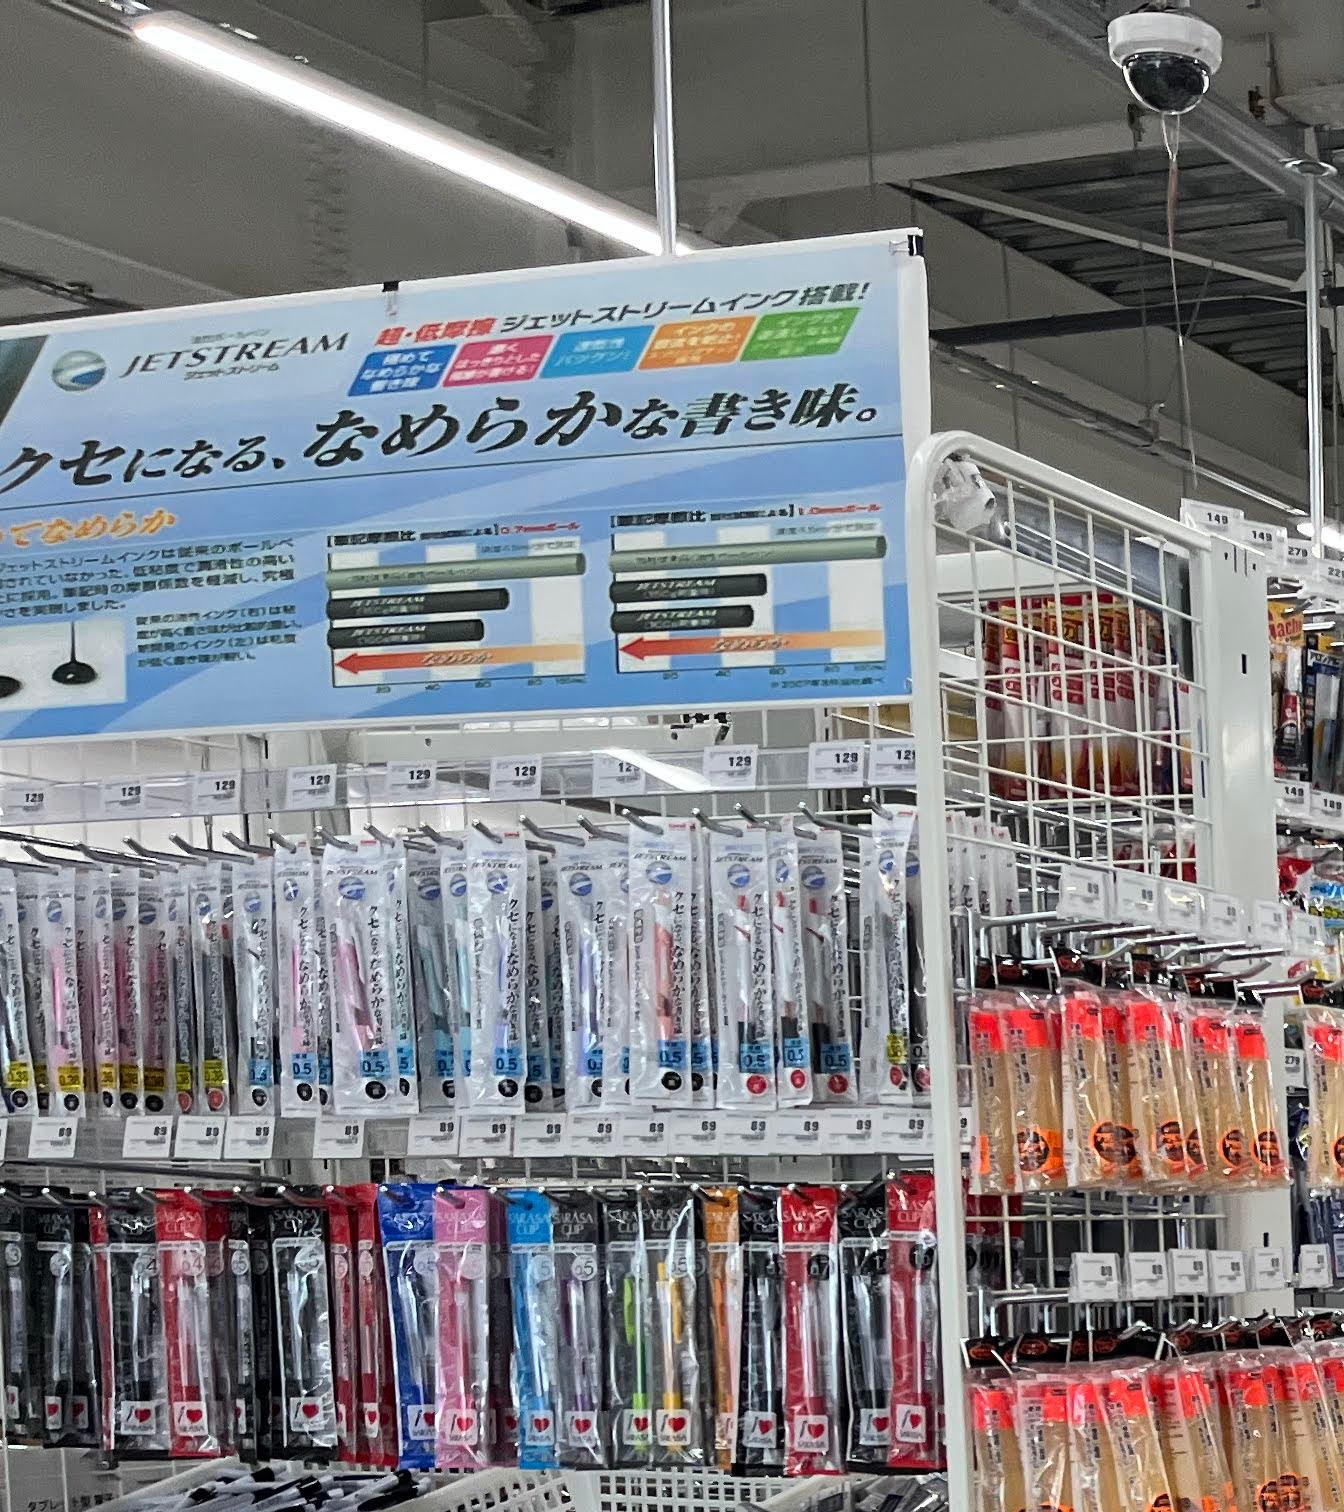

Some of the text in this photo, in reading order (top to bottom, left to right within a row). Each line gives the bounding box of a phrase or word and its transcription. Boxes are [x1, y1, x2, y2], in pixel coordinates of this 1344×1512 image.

[120, 332, 349, 379] JETSTREAM
[0, 507, 177, 547] てなめらか
[727, 756, 753, 767] 129
[834, 752, 860, 764] 129
[407, 768, 432, 781] 129
[513, 765, 538, 777] 129
[310, 774, 332, 786] 129
[362, 1060, 386, 1074] 0.5
[495, 1058, 518, 1074] 0.5
[742, 1053, 765, 1068] 0.5
[823, 1054, 846, 1068] 0.5
[291, 1062, 312, 1076] 0.5
